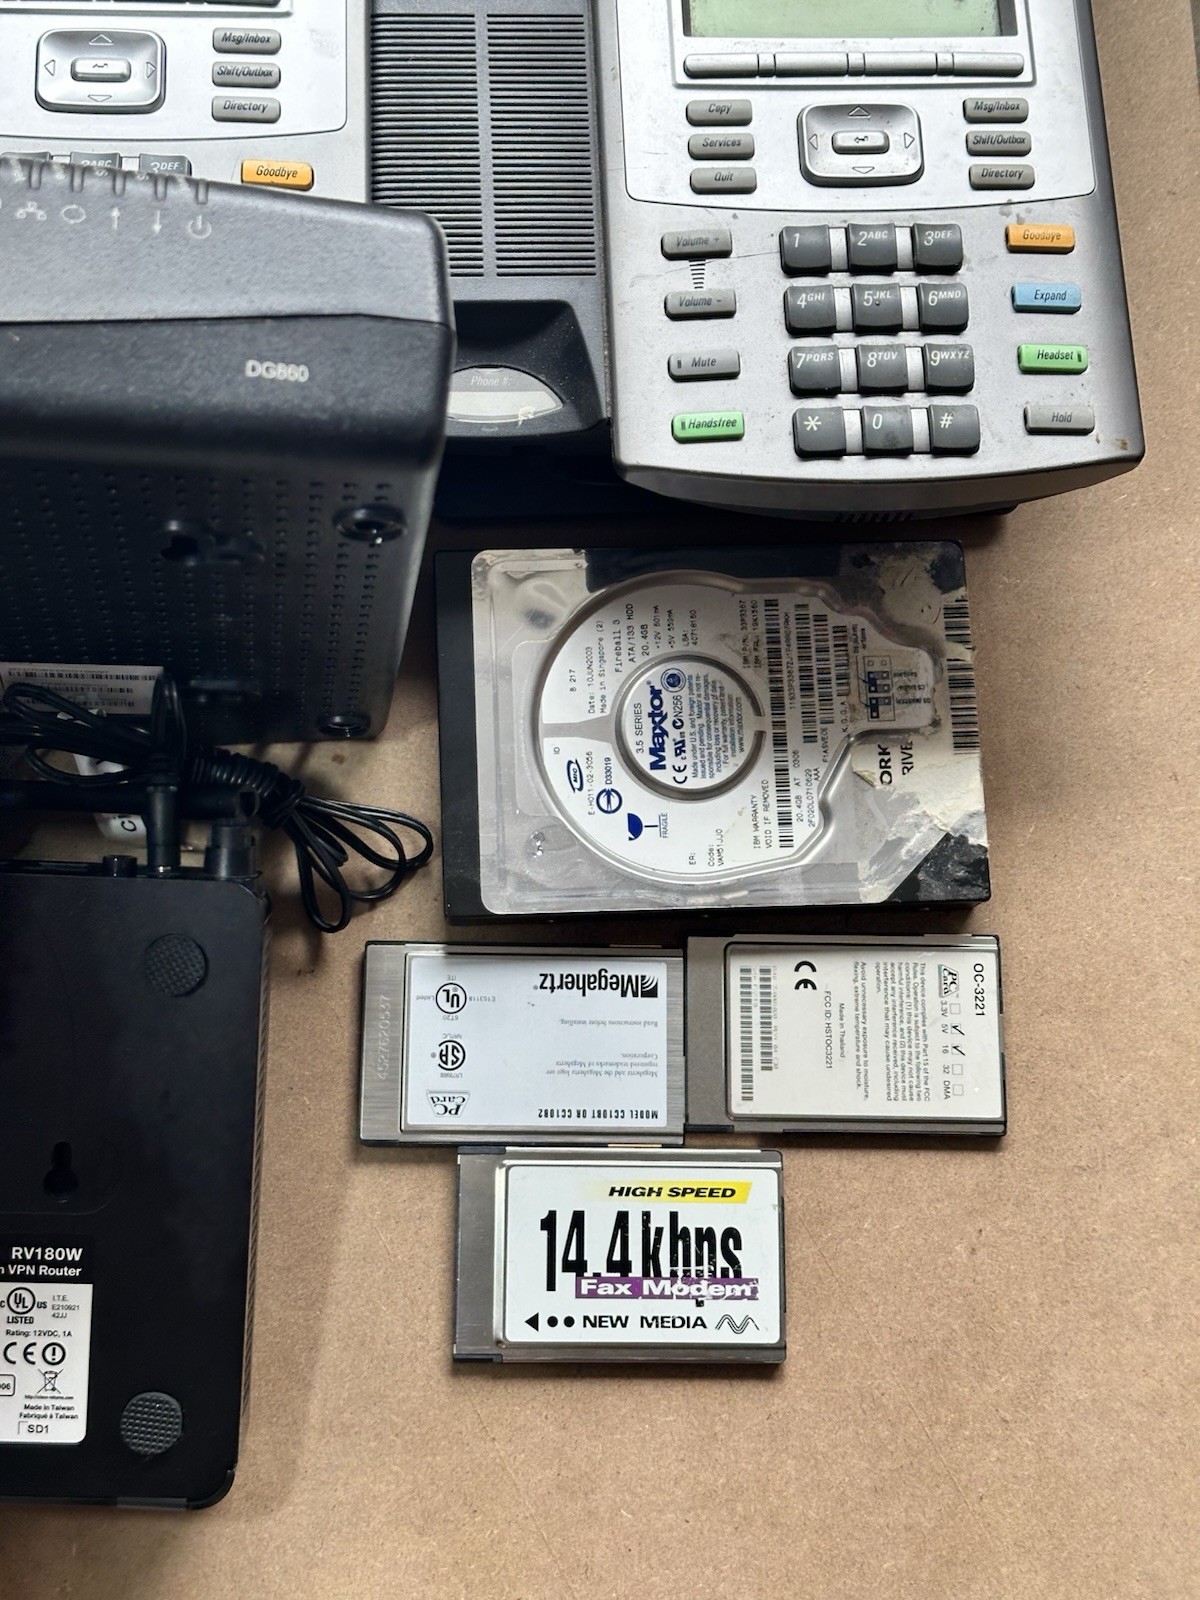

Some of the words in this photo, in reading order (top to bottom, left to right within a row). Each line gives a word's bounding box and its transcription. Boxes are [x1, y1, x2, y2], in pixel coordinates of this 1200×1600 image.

[221, 32, 271, 44] Msg/Inbox
[217, 66, 273, 76] Shift/Outbox
[223, 100, 268, 113] Directory
[709, 104, 732, 114] Copy
[974, 102, 1020, 112] Msg/Inbox
[703, 138, 741, 147] Services
[973, 135, 1026, 145] Shift/Outbox
[256, 165, 298, 180] Goodbye
[715, 172, 734, 181] Quit
[981, 168, 1023, 179] Directory
[793, 232, 800, 247] 1
[1023, 229, 1062, 241] Goodbye
[676, 236, 709, 247] Volume
[678, 296, 712, 307] Volume
[1034, 290, 1067, 302] Expand
[1037, 349, 1074, 360] Headset
[691, 356, 717, 367] Mute
[471, 376, 499, 386] Phone
[688, 417, 737, 429] Handsfree
[872, 413, 882, 429] 0
[1052, 412, 1072, 423] Hold
[626, 604, 634, 620] HDD
[628, 625, 636, 663] ATA/133
[641, 624, 649, 656] 20.4GB
[614, 630, 622, 672] Fireball
[597, 637, 606, 678] Singapore
[599, 682, 606, 690] in
[687, 674, 695, 696] patents
[673, 695, 683, 718] N256
[688, 696, 696, 717] foreign
[634, 702, 643, 736] SERIES
[636, 740, 644, 754] 3.5
[605, 757, 613, 785] D33019
[691, 761, 699, 778] Made
[794, 777, 801, 787] AT
[762, 779, 770, 812] REMOVED
[751, 794, 760, 832] WARRANTY
[796, 794, 804, 822] 20.4GB
[763, 816, 770, 825] IF
[752, 835, 761, 849] IBM
[764, 829, 772, 848] VOID
[948, 971, 958, 992] PC
[973, 963, 985, 1016] OC-3221
[860, 982, 868, 1024] unnecessary
[920, 999, 928, 1027] complies
[559, 1018, 587, 1026] installing.
[942, 1024, 949, 1034] 5V
[942, 1045, 949, 1054] 16
[923, 1058, 929, 1066] 15
[943, 1065, 950, 1074] 32
[430, 1095, 466, 1105] Card
[434, 1103, 462, 1115] PC
[538, 1108, 572, 1118] CC10B2
[576, 1109, 587, 1118] OR
[591, 1109, 625, 1118] CC10BT
[629, 1109, 658, 1119] MODEL
[608, 1185, 663, 1198] HIGH
[667, 1186, 737, 1199] SPEED
[11, 1247, 83, 1261] RV180W
[8, 1265, 35, 1275] VPN
[39, 1265, 82, 1276] Router
[580, 1278, 632, 1296] Fax
[7, 1316, 34, 1324] LISTED
[582, 1315, 629, 1329] NEW
[639, 1316, 708, 1329] MEDIA
[6, 1329, 31, 1337] Rating:
[27, 1424, 49, 1433] SD1
